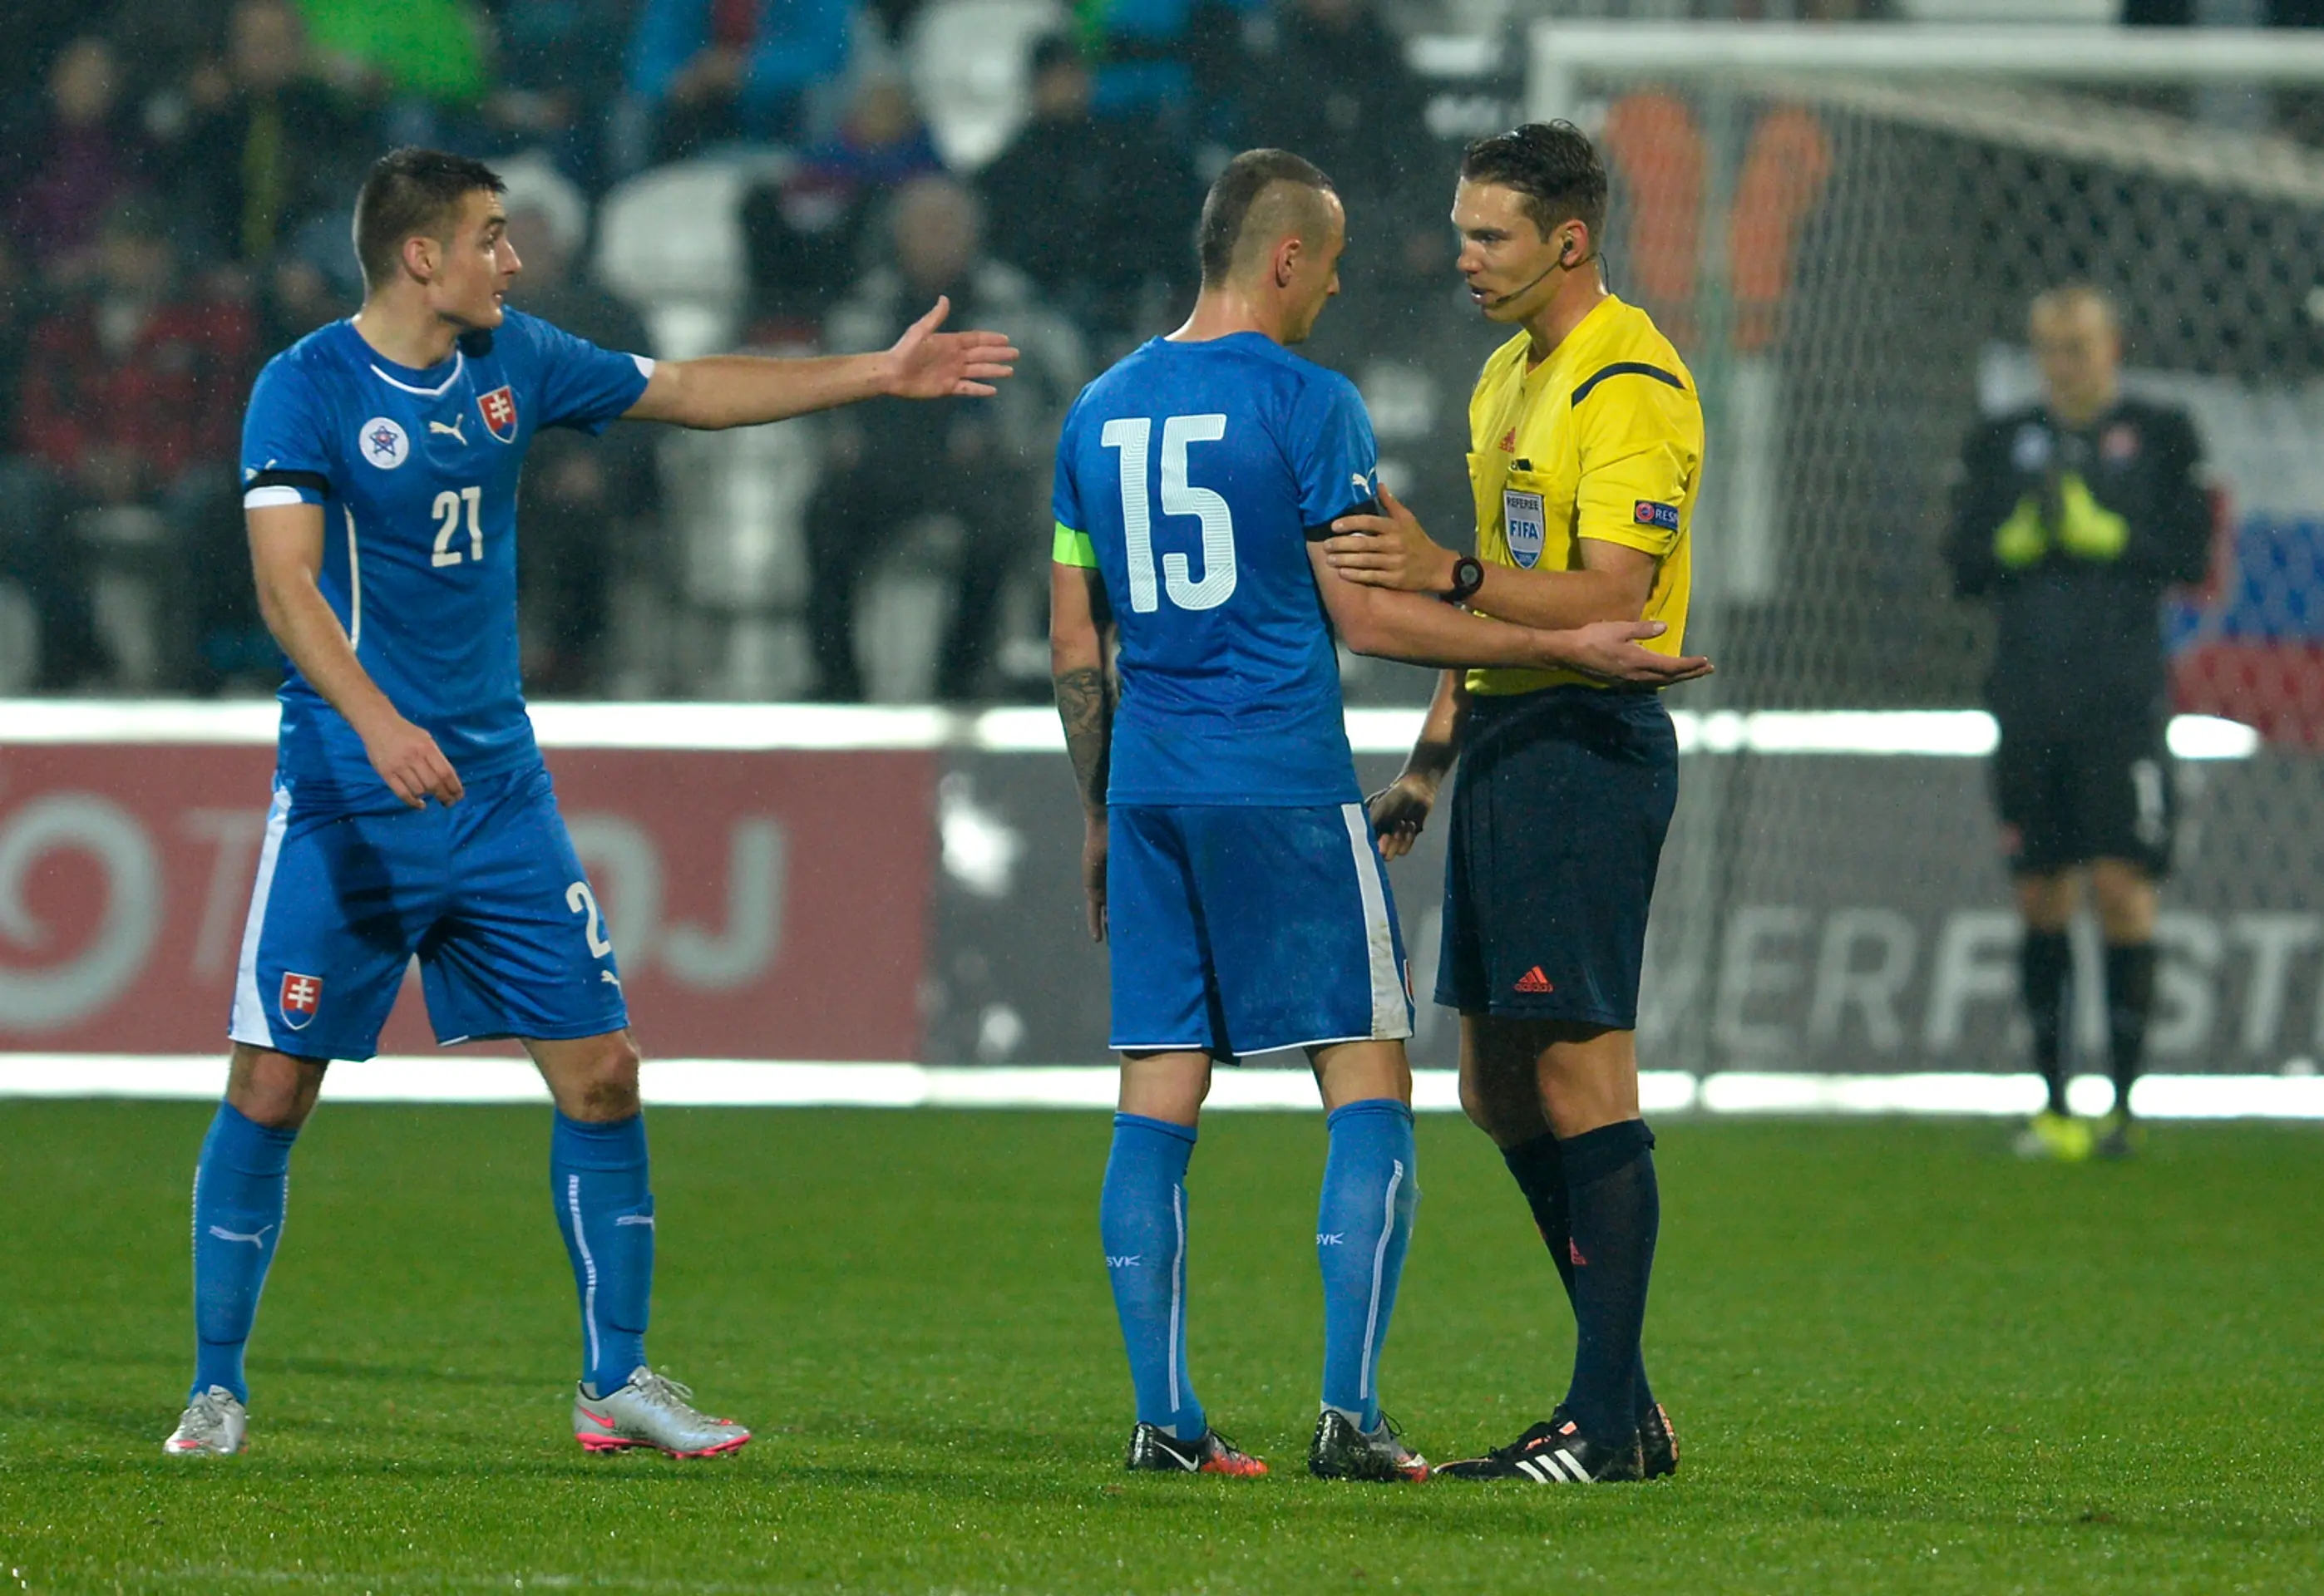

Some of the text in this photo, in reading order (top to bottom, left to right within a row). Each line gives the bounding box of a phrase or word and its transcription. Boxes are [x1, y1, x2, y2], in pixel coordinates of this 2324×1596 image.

[1507, 496, 1539, 510] REFEREE
[1101, 414, 1237, 613] 15
[431, 486, 483, 567] 21
[1510, 520, 1539, 539] FIFA
[1106, 1254, 1142, 1268] SVK
